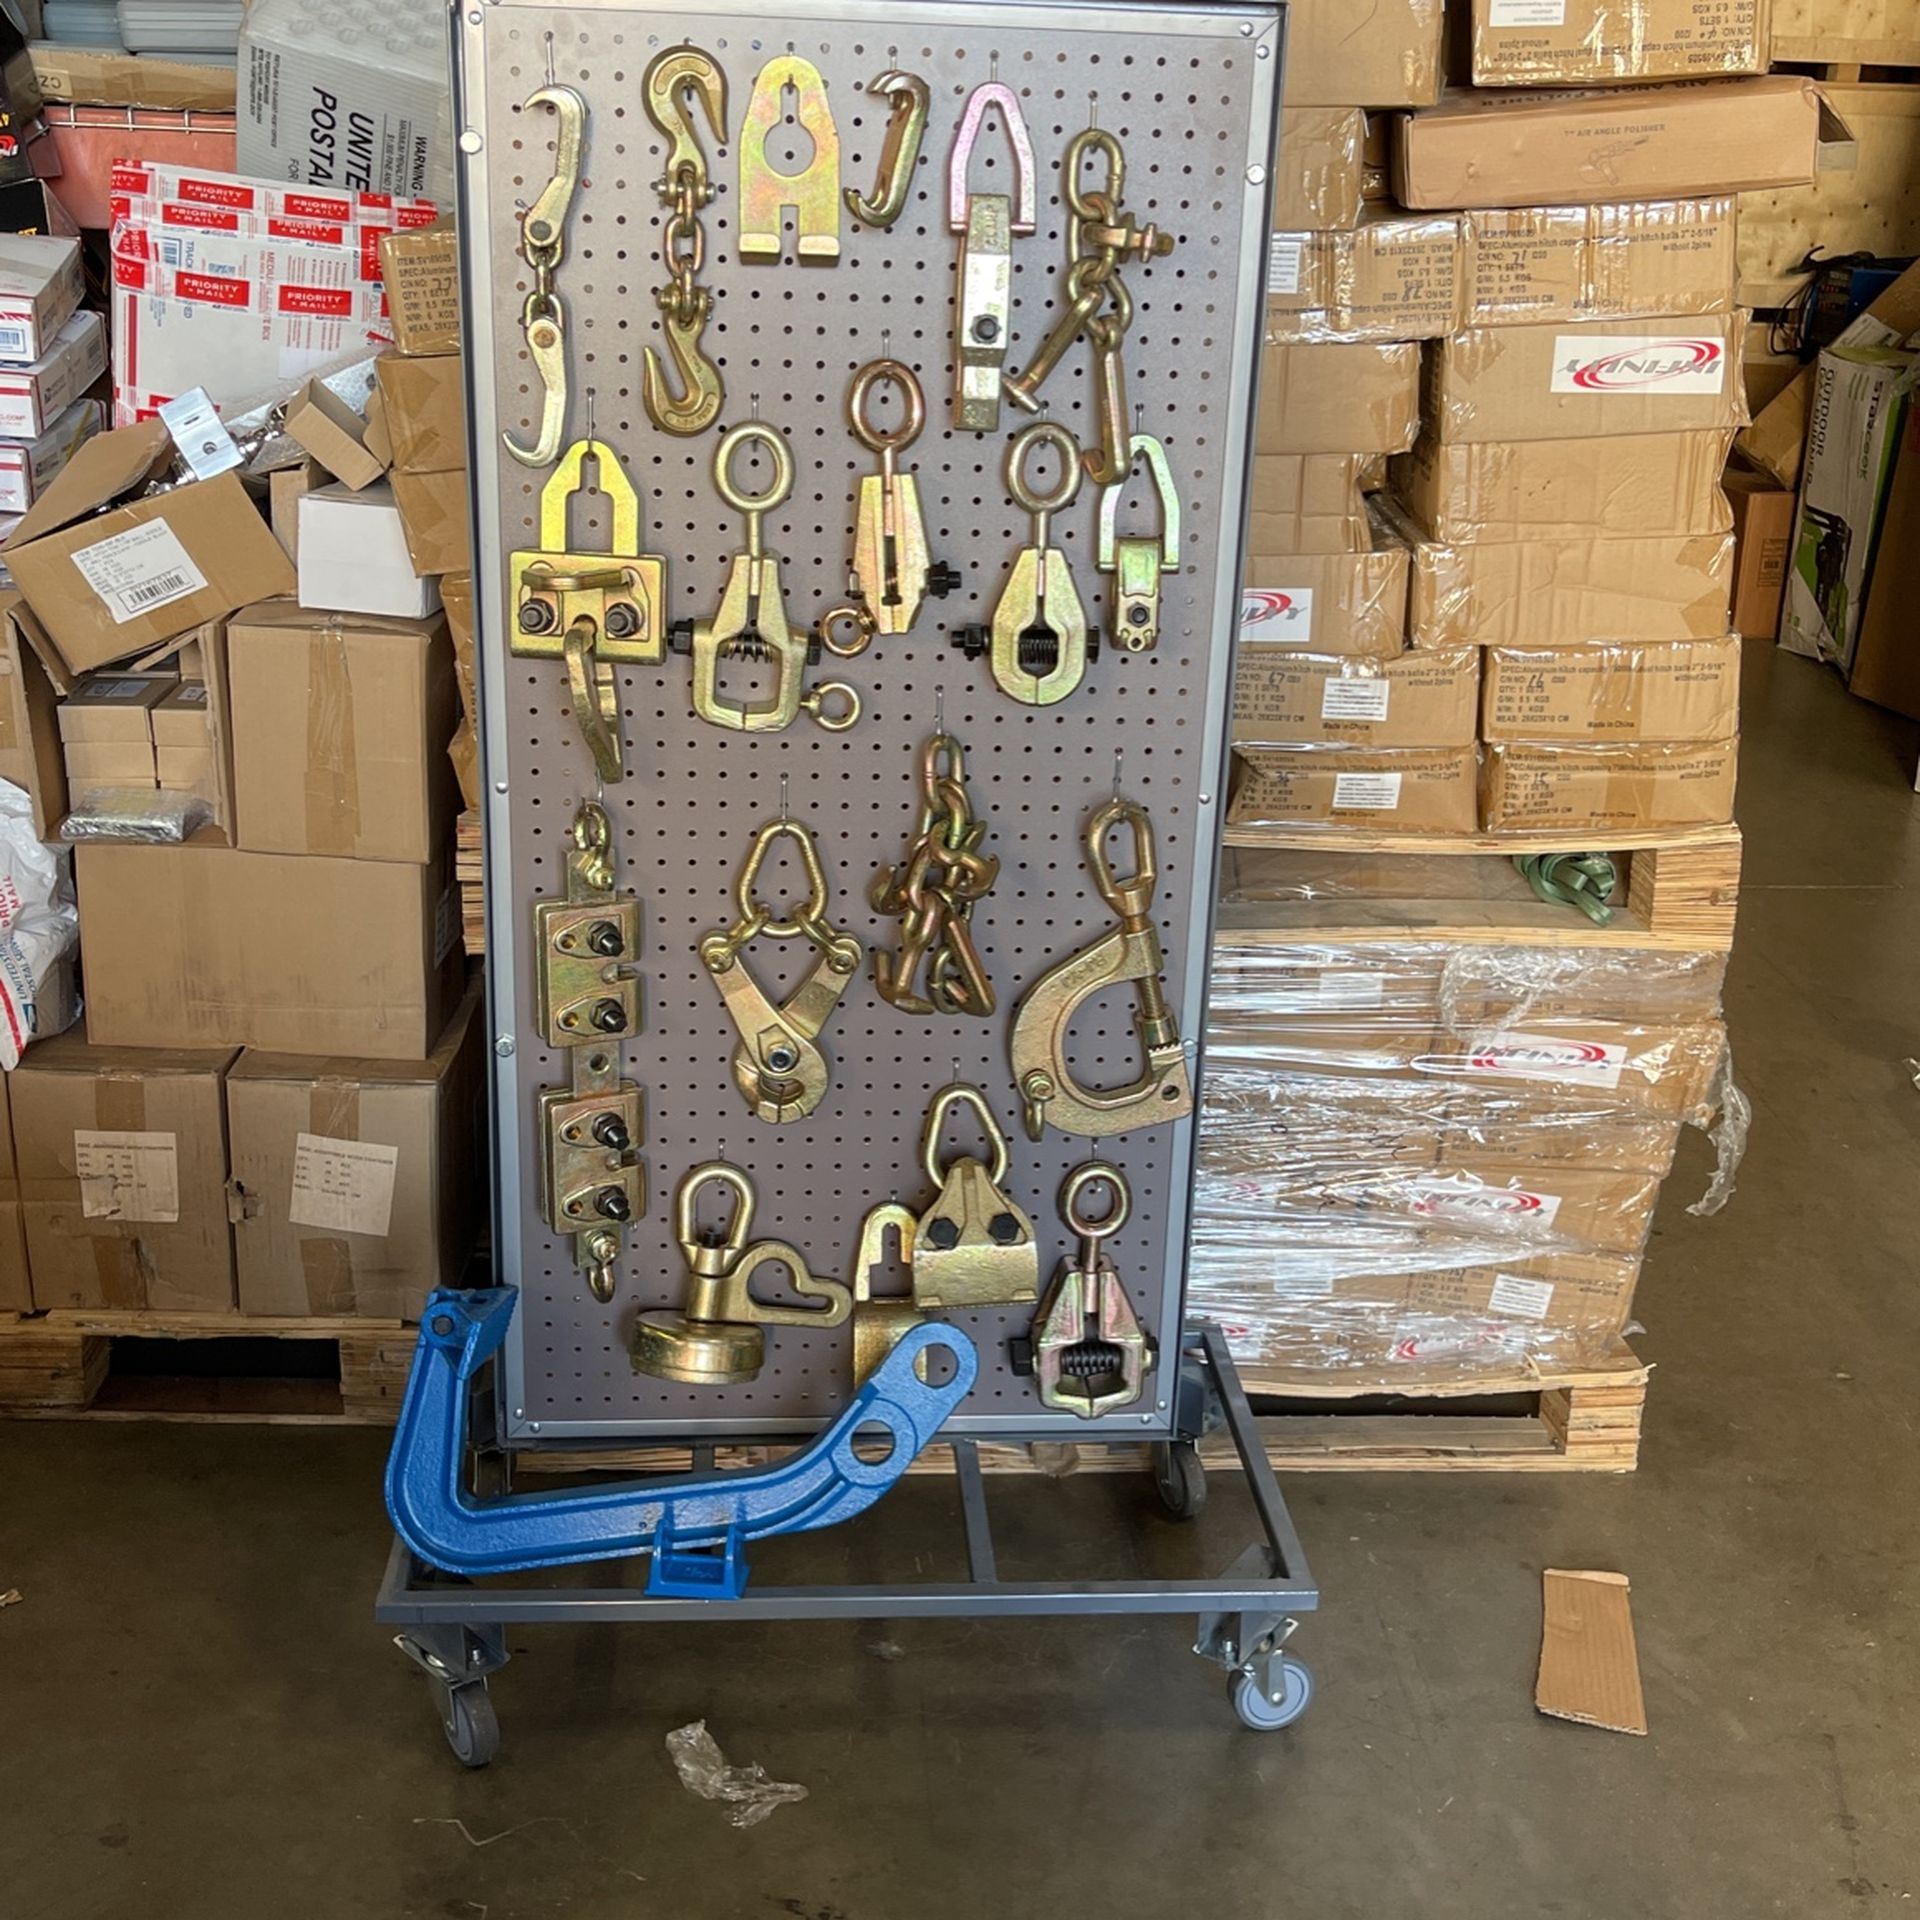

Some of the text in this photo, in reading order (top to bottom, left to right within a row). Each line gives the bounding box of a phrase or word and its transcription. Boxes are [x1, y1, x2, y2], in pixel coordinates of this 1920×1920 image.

[1699, 16, 1721, 26] SETS
[1499, 40, 1550, 50] without 2pins
[1534, 51, 1552, 60] balls
[1554, 49, 1574, 59] hitch
[1594, 127, 1621, 135] ANGLE
[1624, 124, 1666, 133] POLISHER
[345, 112, 375, 192] UNITE
[288, 158, 300, 180] FOR
[411, 136, 428, 192] WARNING
[187, 185, 244, 198] PRIORITY
[200, 193, 229, 202] MAIL
[292, 200, 347, 211] PRIORITY
[171, 208, 227, 219] PRIORITY
[184, 216, 213, 224] MAIL
[277, 221, 331, 232] PRIORITY
[289, 228, 318, 237] MAIL
[1663, 241, 1711, 251] without 2pins
[1403, 258, 1419, 266] KGS
[1397, 270, 1414, 278] KGS
[183, 278, 239, 293] PRIORITY
[196, 289, 225, 298] MAIL
[287, 292, 342, 303] PRIORITY
[1556, 358, 1722, 374] INFINITY
[1816, 369, 1835, 456] OUTDOOR
[1408, 678, 1453, 687] without 2pins
[1322, 722, 1341, 730] Made
[3, 874, 20, 909] MAIL
